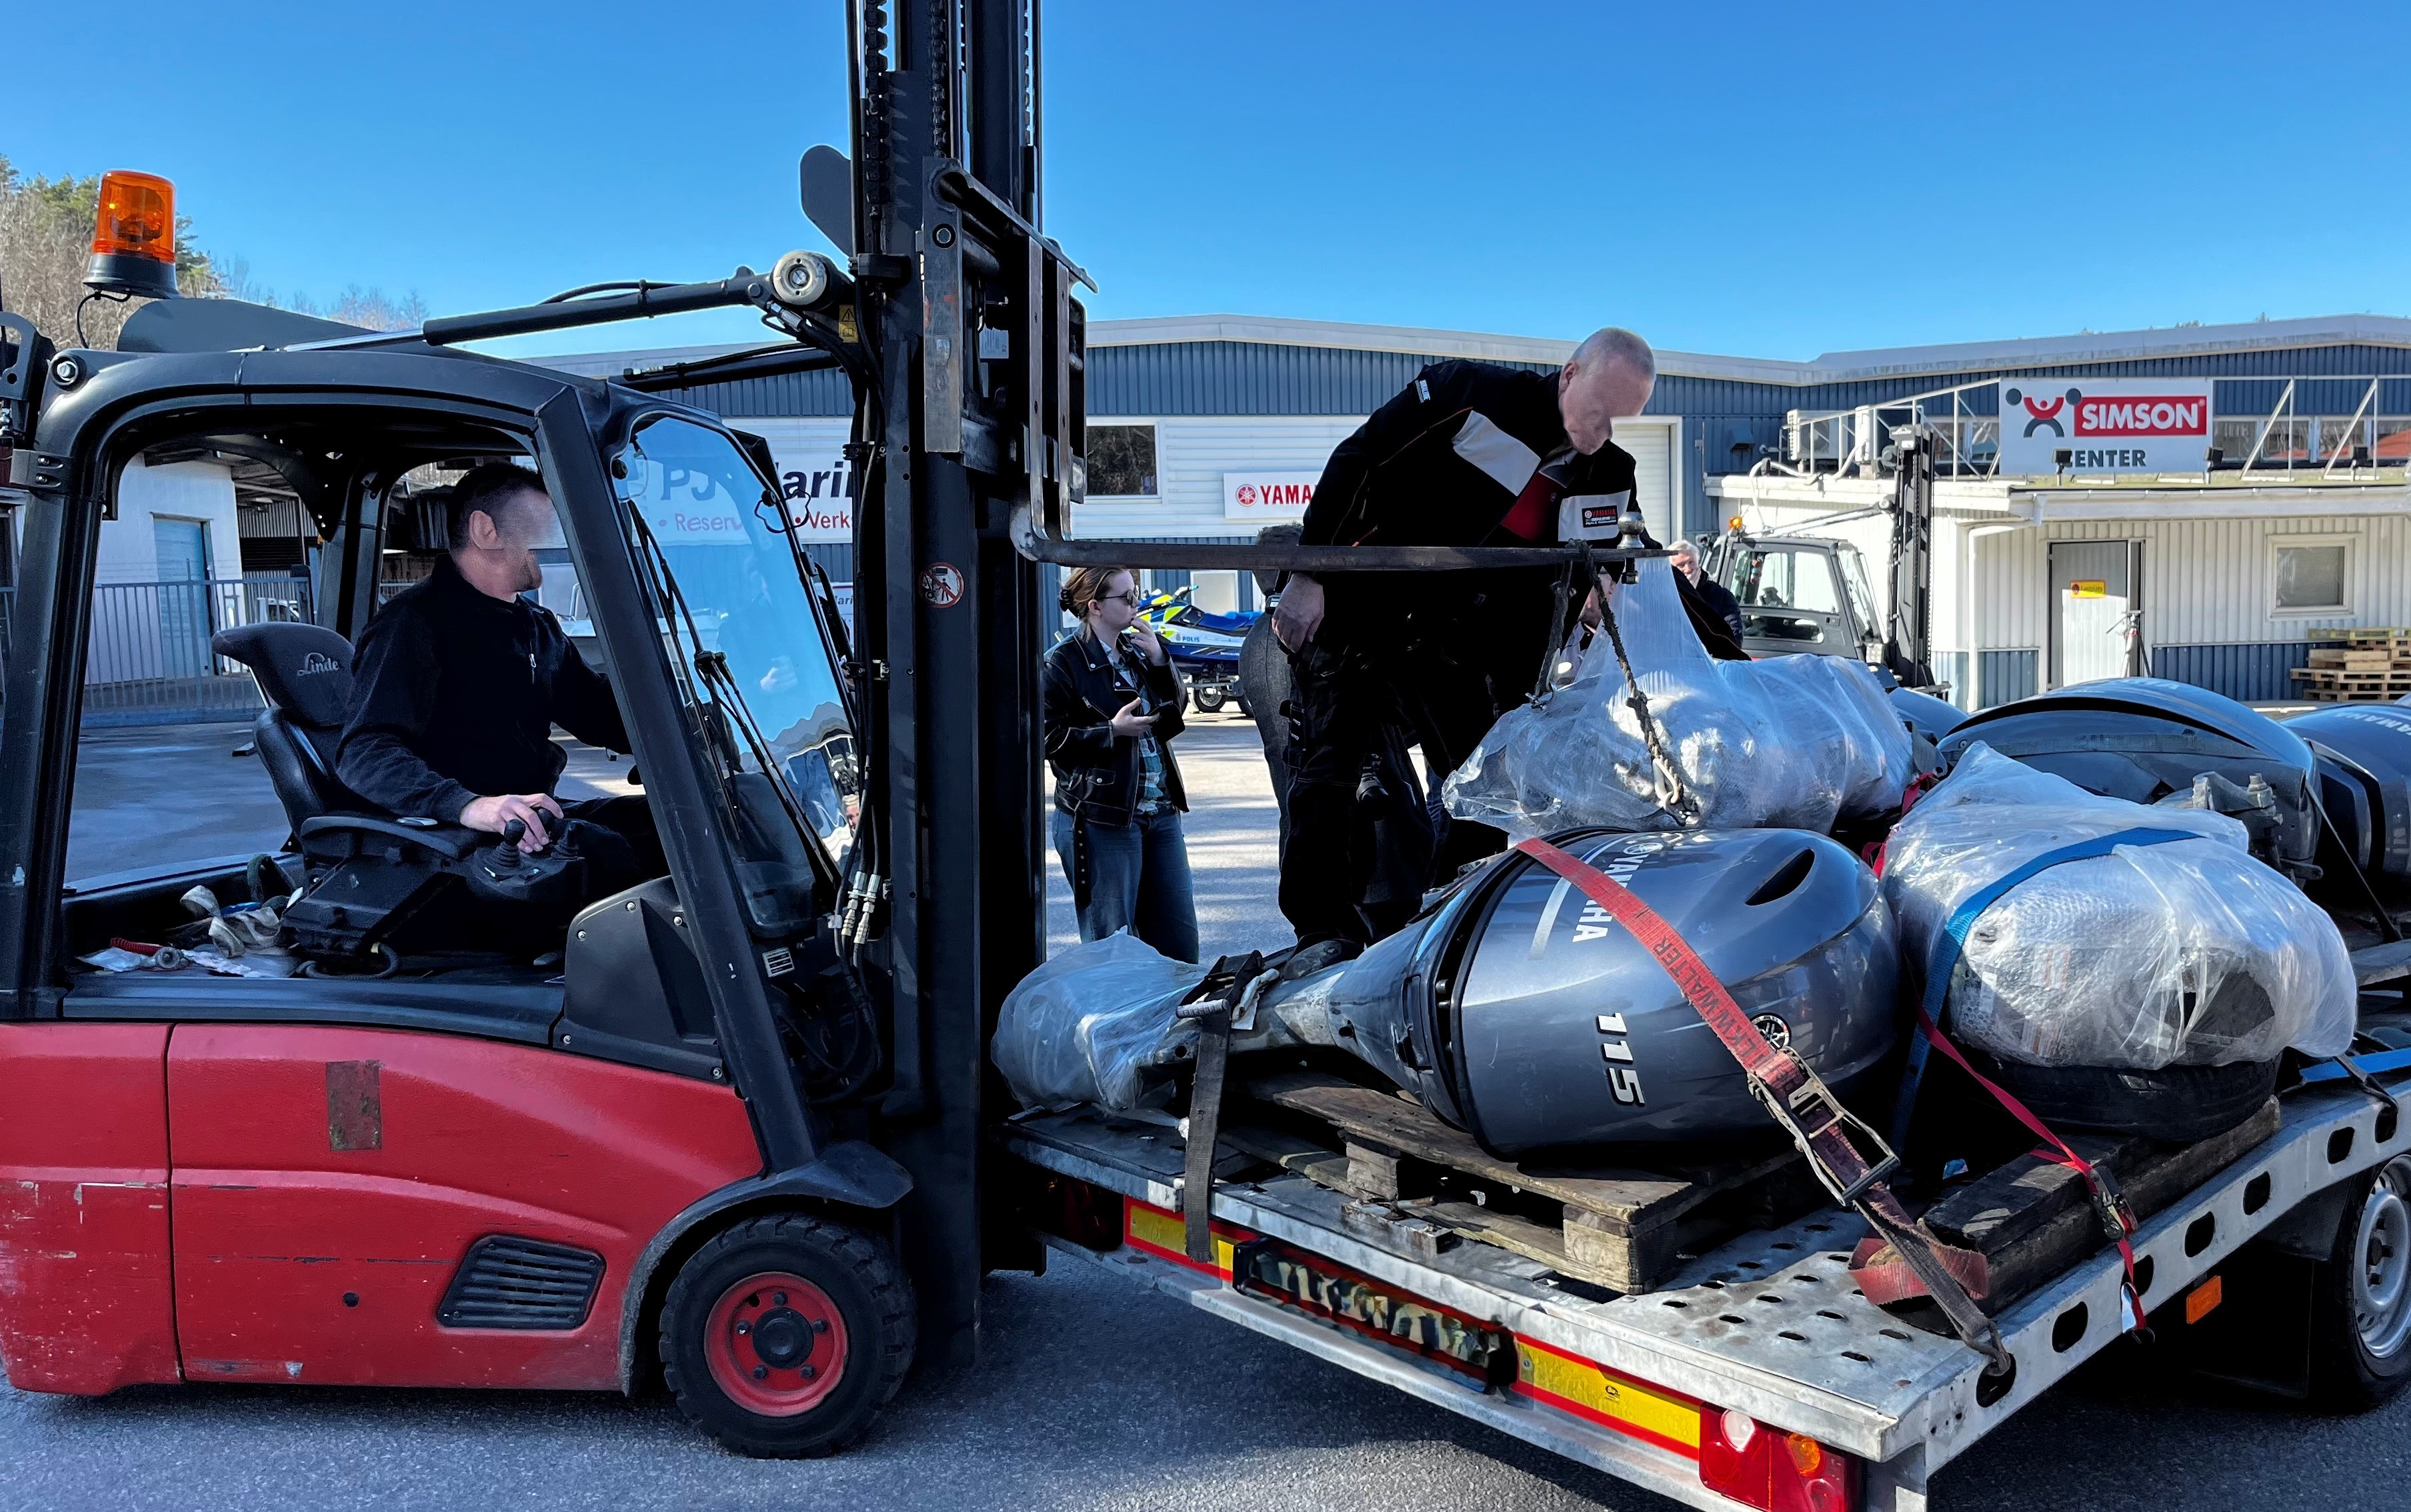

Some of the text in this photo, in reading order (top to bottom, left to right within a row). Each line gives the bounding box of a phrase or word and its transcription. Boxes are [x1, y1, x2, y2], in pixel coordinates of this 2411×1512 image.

[2082, 403, 2198, 430] SIMSON
[2069, 449, 2147, 467] ENTER
[661, 461, 853, 501] PJ ari
[1260, 485, 1317, 505] YAMA
[808, 511, 853, 529] Verk
[835, 595, 853, 605] ari
[297, 653, 339, 676] Linde
[1654, 935, 1720, 1017] WALTER
[1597, 1012, 1646, 1107] 115
